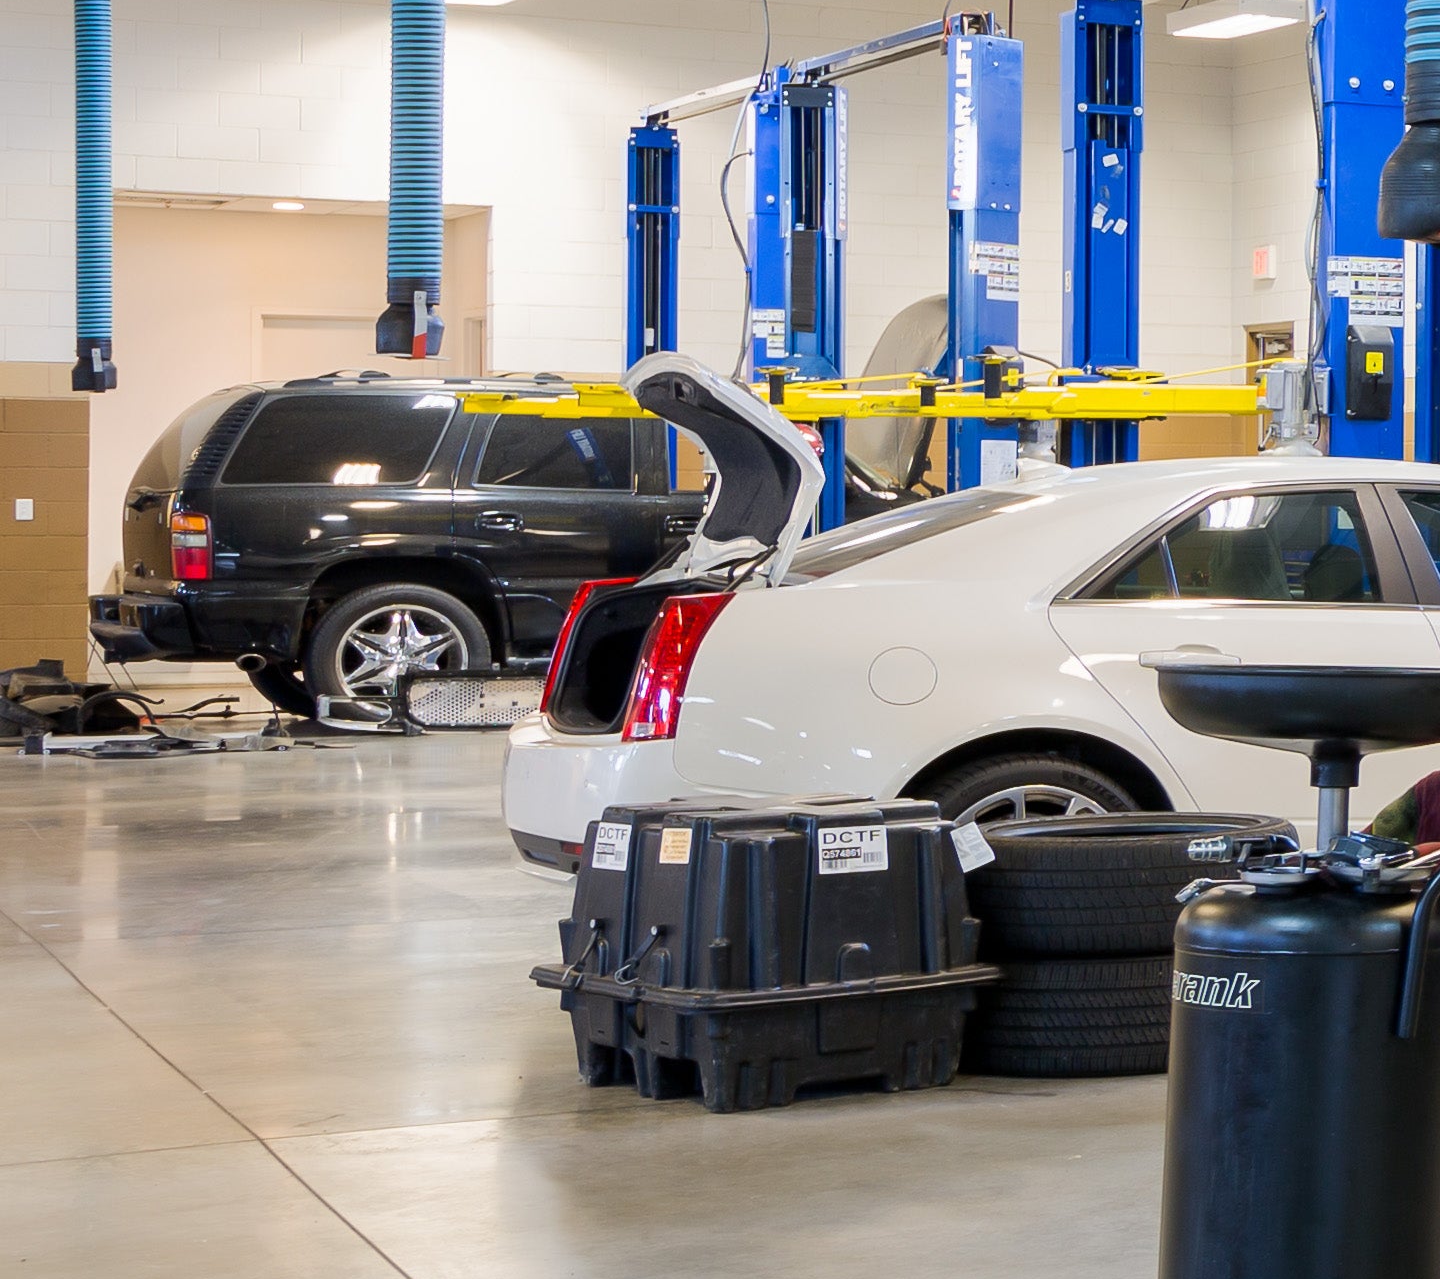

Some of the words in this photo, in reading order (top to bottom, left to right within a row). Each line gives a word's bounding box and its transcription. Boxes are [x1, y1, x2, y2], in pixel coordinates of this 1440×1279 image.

[955, 38, 973, 87] LIFT
[599, 826, 628, 840] DCTF
[823, 829, 881, 845] DCTF
